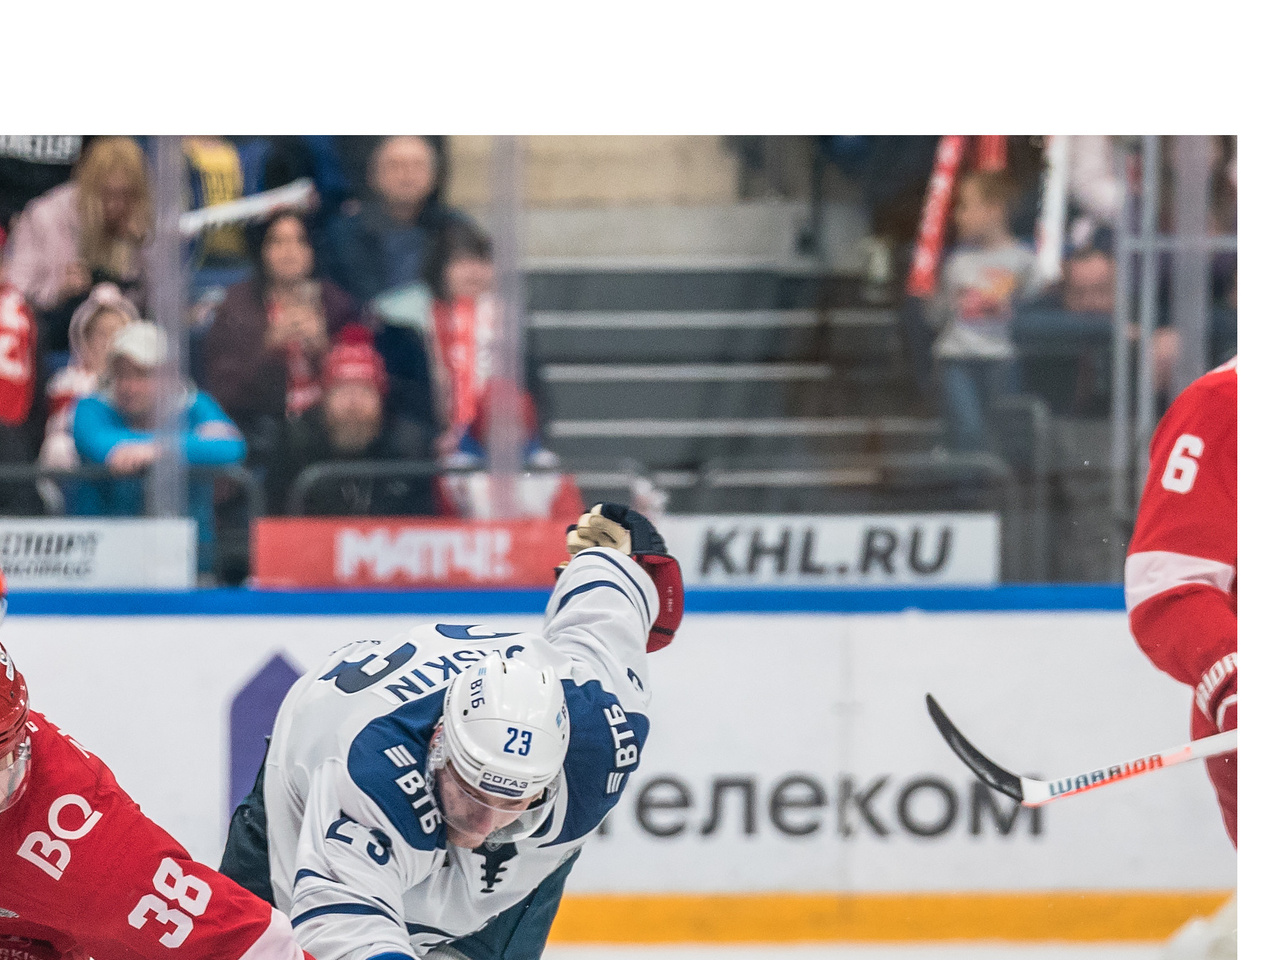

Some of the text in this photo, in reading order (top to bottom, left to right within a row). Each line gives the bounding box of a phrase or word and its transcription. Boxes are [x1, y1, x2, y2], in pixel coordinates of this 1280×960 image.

[1161, 433, 1206, 496] 6
[698, 525, 953, 578] KHL.RU
[503, 727, 533, 757] 23
[603, 704, 638, 768] ВТБ
[394, 769, 443, 834] ВТБ
[482, 771, 529, 789] СОГАЗ
[596, 773, 1046, 840] елеком
[16, 793, 104, 881] BQ
[128, 857, 213, 949] 38
